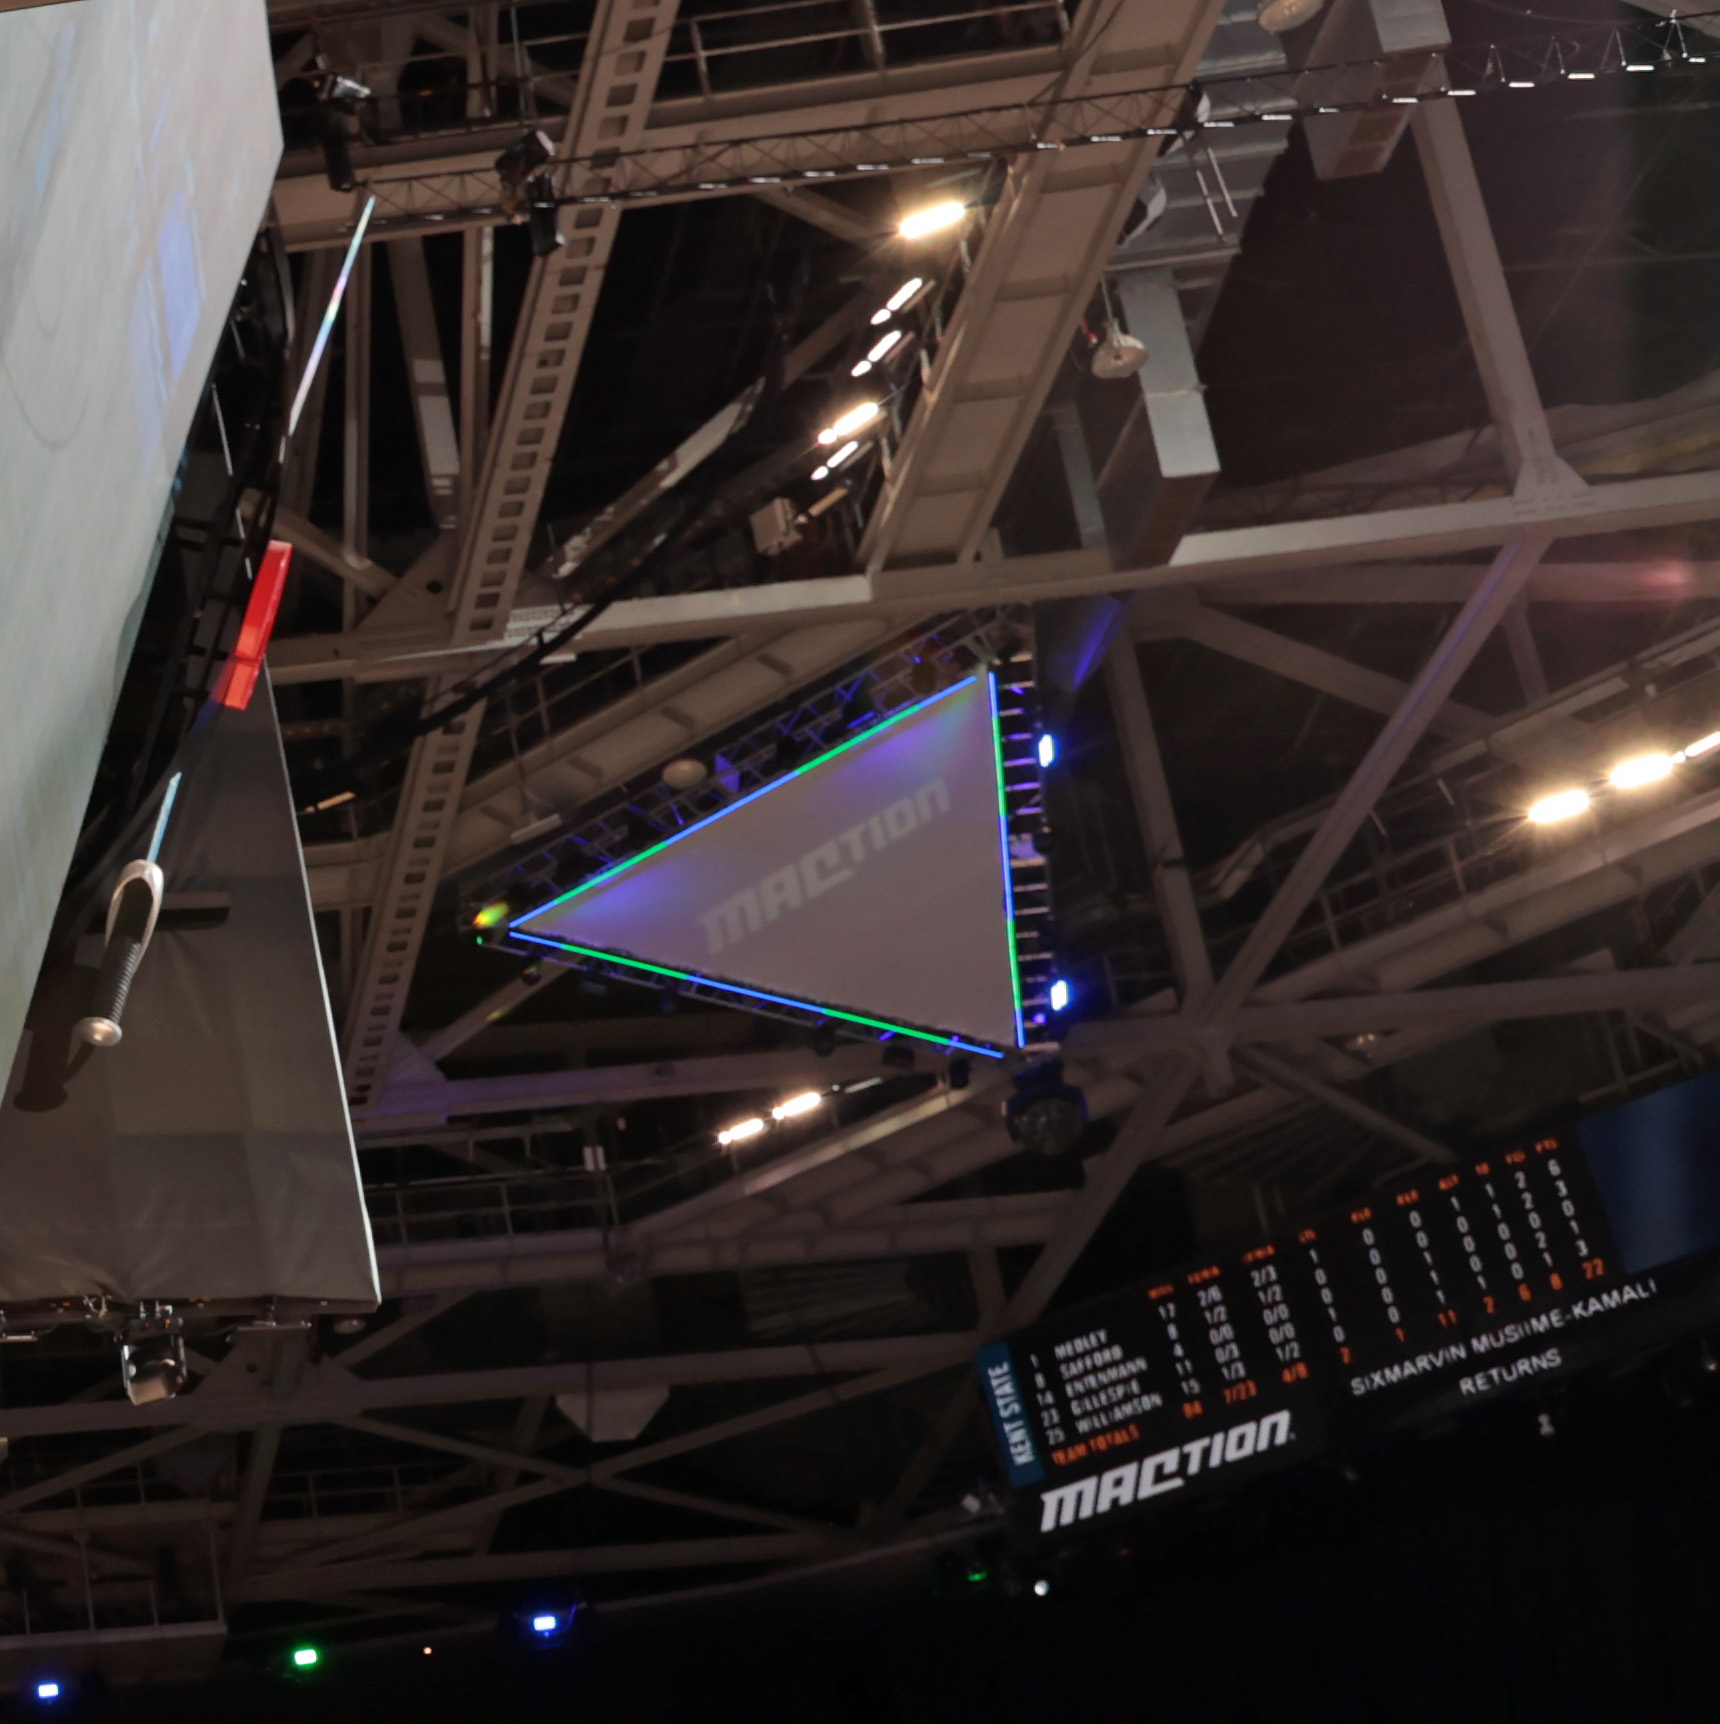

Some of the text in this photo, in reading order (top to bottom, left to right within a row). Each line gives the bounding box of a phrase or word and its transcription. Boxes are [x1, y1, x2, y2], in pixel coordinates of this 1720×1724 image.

[701, 777, 952, 955] MACTION
[1459, 1348, 1563, 1397] RETURNS
[1039, 1409, 1292, 1534] MACTION
